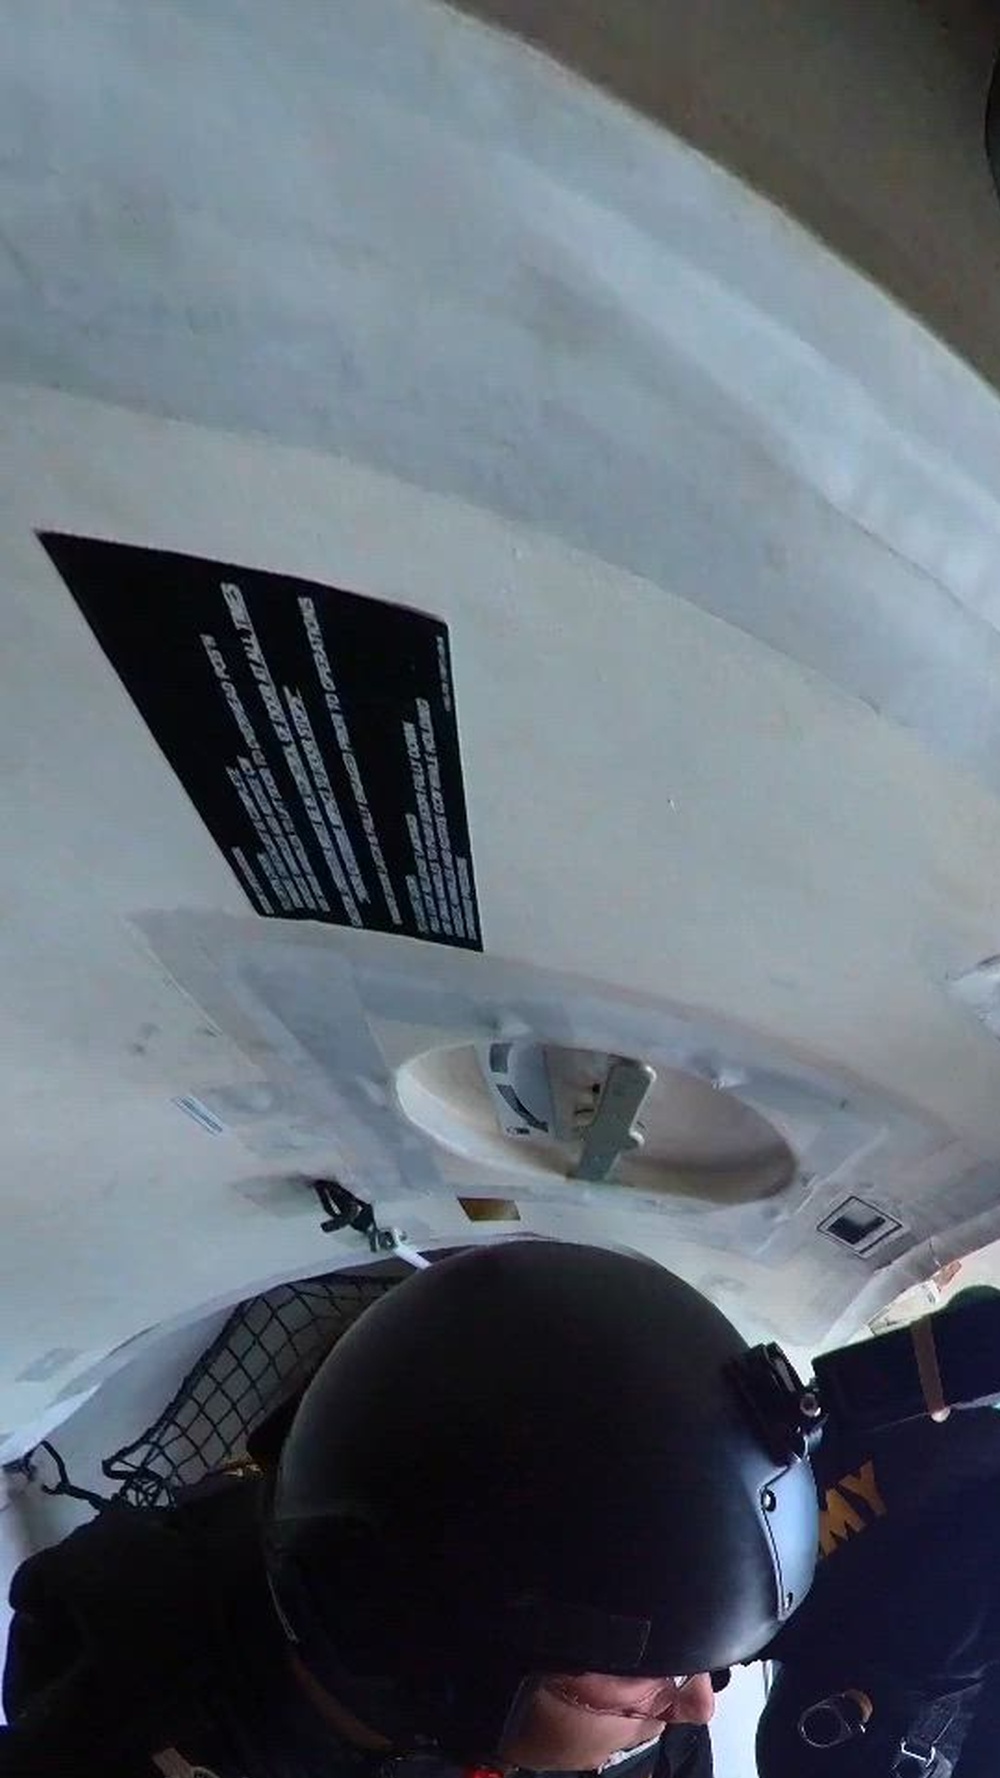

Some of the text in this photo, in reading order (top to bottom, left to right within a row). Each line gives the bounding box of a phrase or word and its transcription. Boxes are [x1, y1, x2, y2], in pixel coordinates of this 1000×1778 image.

[296, 595, 338, 692] OPERATIONS
[324, 692, 344, 712] TO
[818, 1459, 888, 1559] MY
